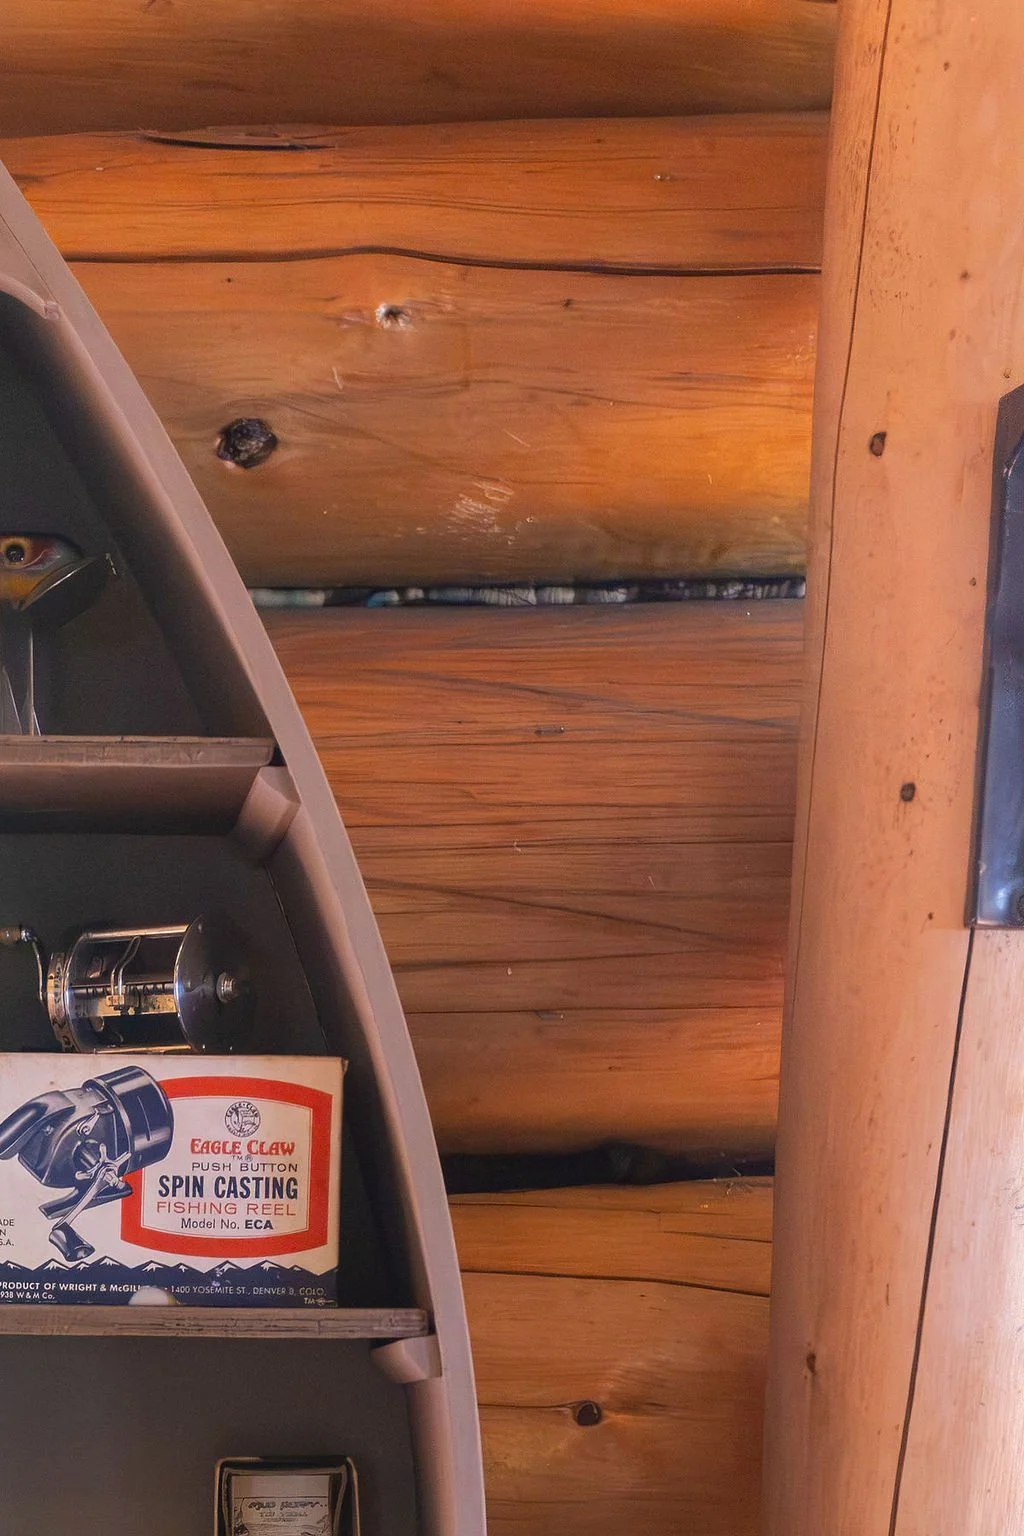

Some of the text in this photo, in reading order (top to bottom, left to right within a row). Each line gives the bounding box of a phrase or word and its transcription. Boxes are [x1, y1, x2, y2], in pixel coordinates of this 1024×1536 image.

[190, 1138, 295, 1156] EAGLE CLAW
[191, 1162, 298, 1172] PUSH BUTTON
[158, 1175, 298, 1200] SPIN CASTING
[156, 1201, 296, 1216] FISHING REEL
[181, 1218, 274, 1230] Model No. ECA
[43, 1282, 57, 1290] OF
[59, 1283, 97, 1292] WRIGHT
[100, 1284, 107, 1292] &
[192, 1286, 234, 1294] YOSEMITE
[253, 1287, 286, 1295] DENVER
